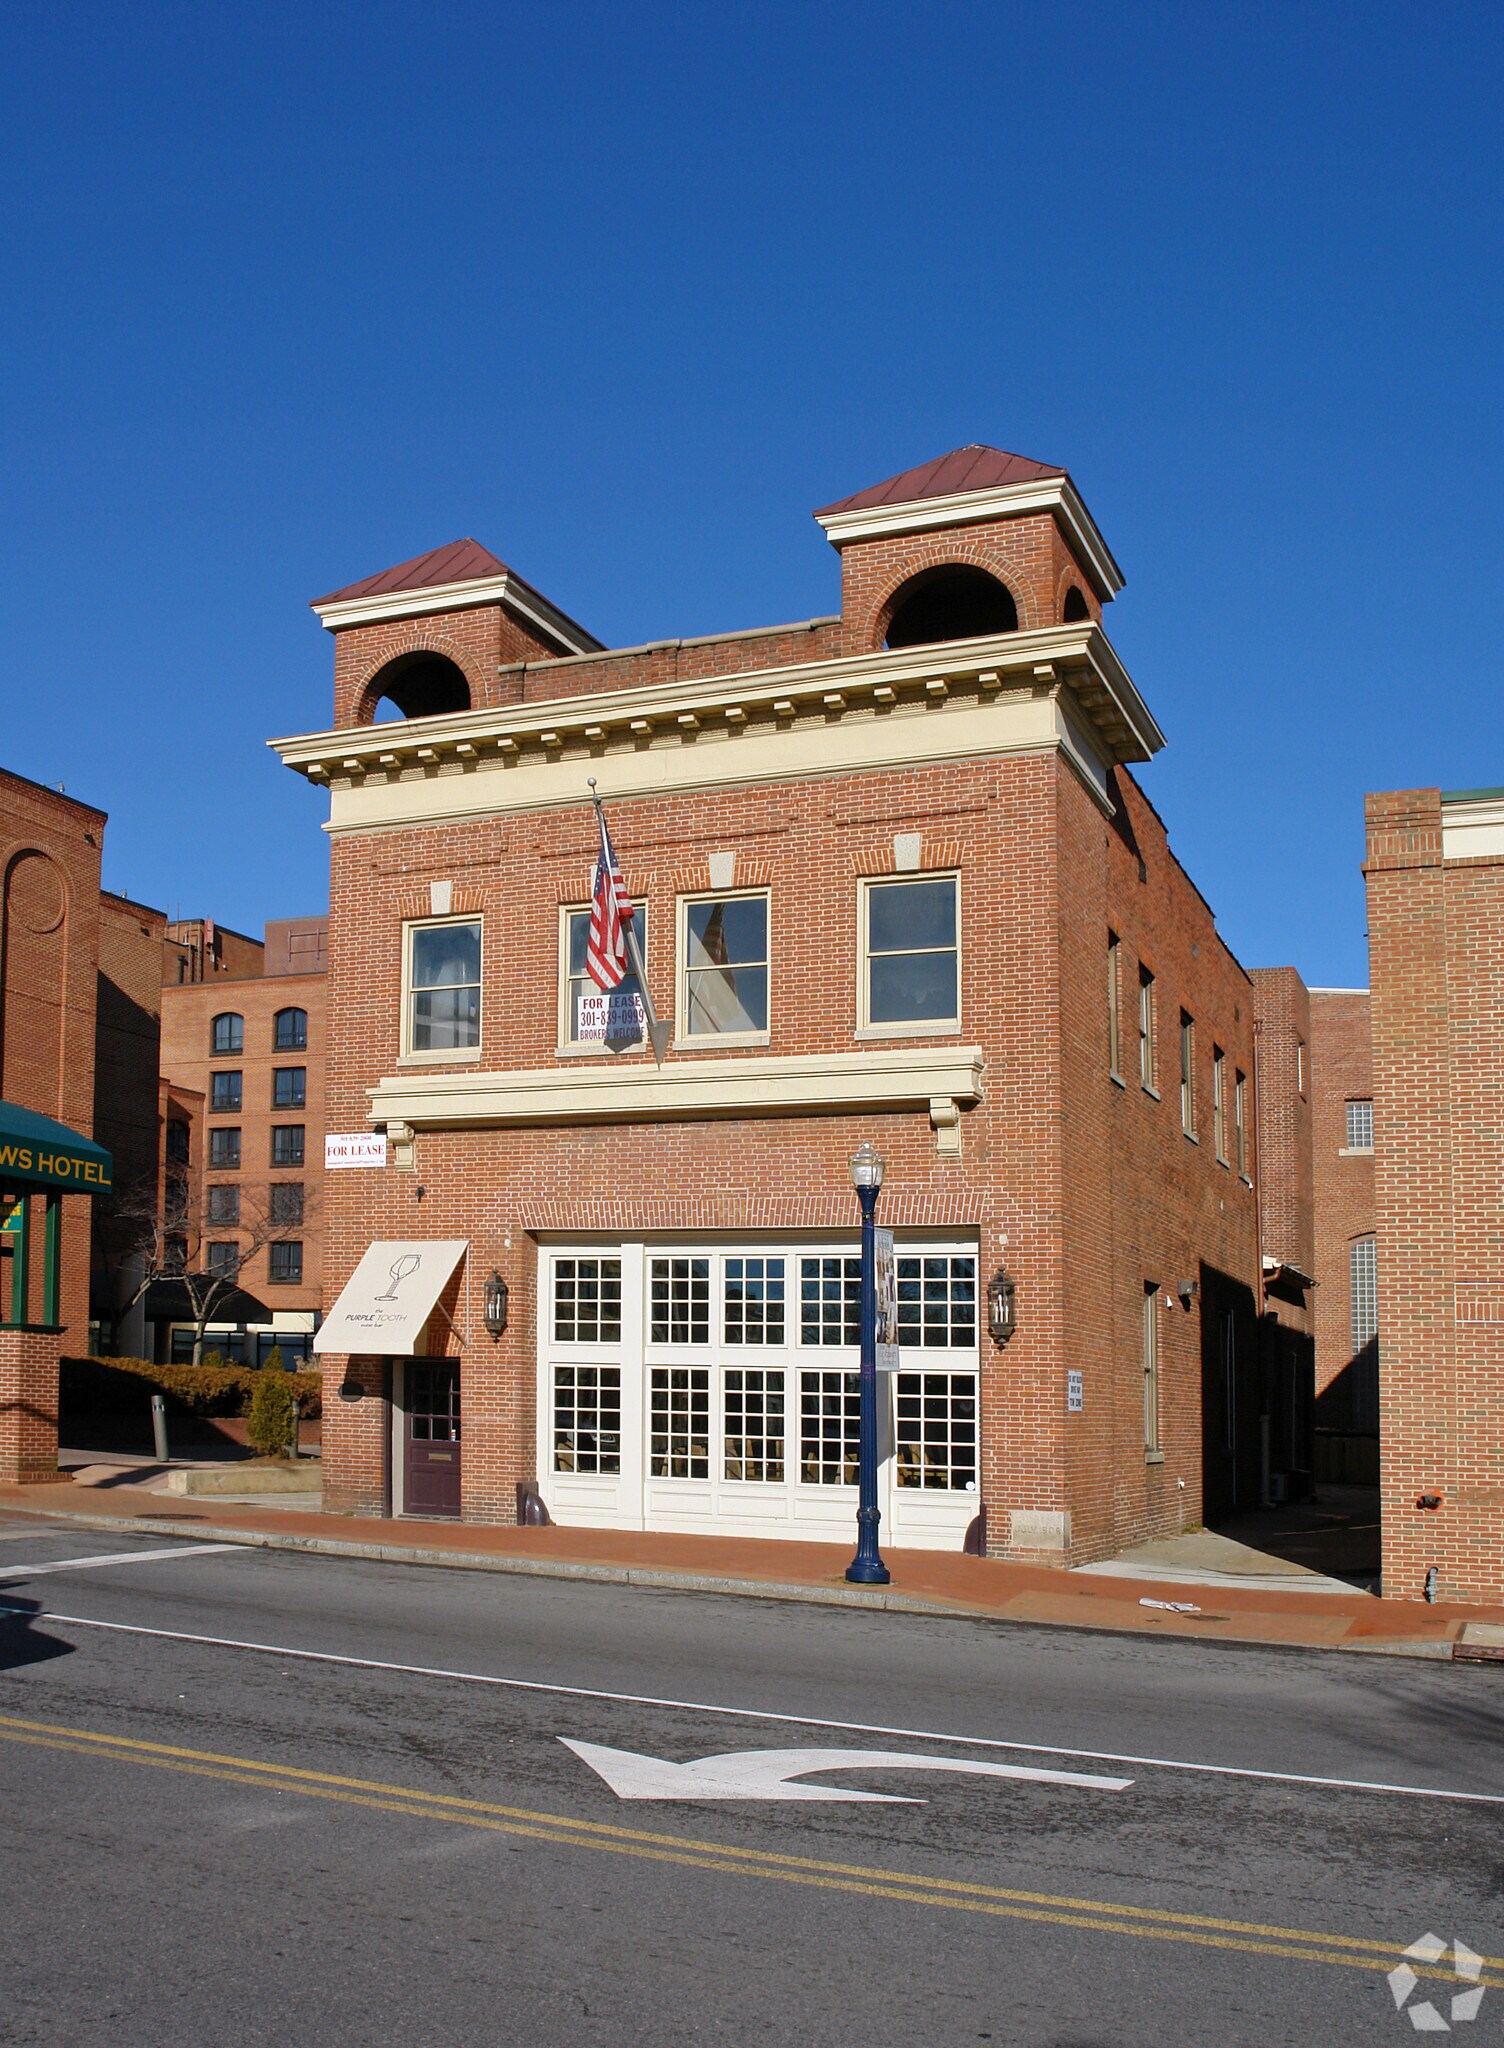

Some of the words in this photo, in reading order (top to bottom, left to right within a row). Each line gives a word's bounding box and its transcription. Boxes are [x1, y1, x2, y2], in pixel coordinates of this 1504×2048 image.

[583, 998, 603, 1010] FOR
[609, 995, 641, 1008] LEASE
[580, 1008, 645, 1027] 301-839-0999
[580, 1028, 611, 1041] BROKERS
[613, 1026, 645, 1039] WELCOME
[327, 1145, 348, 1157] FOR
[351, 1144, 385, 1156] LEASE
[37, 1152, 112, 1186] HOTEL
[377, 1314, 408, 1322] TOOTH
